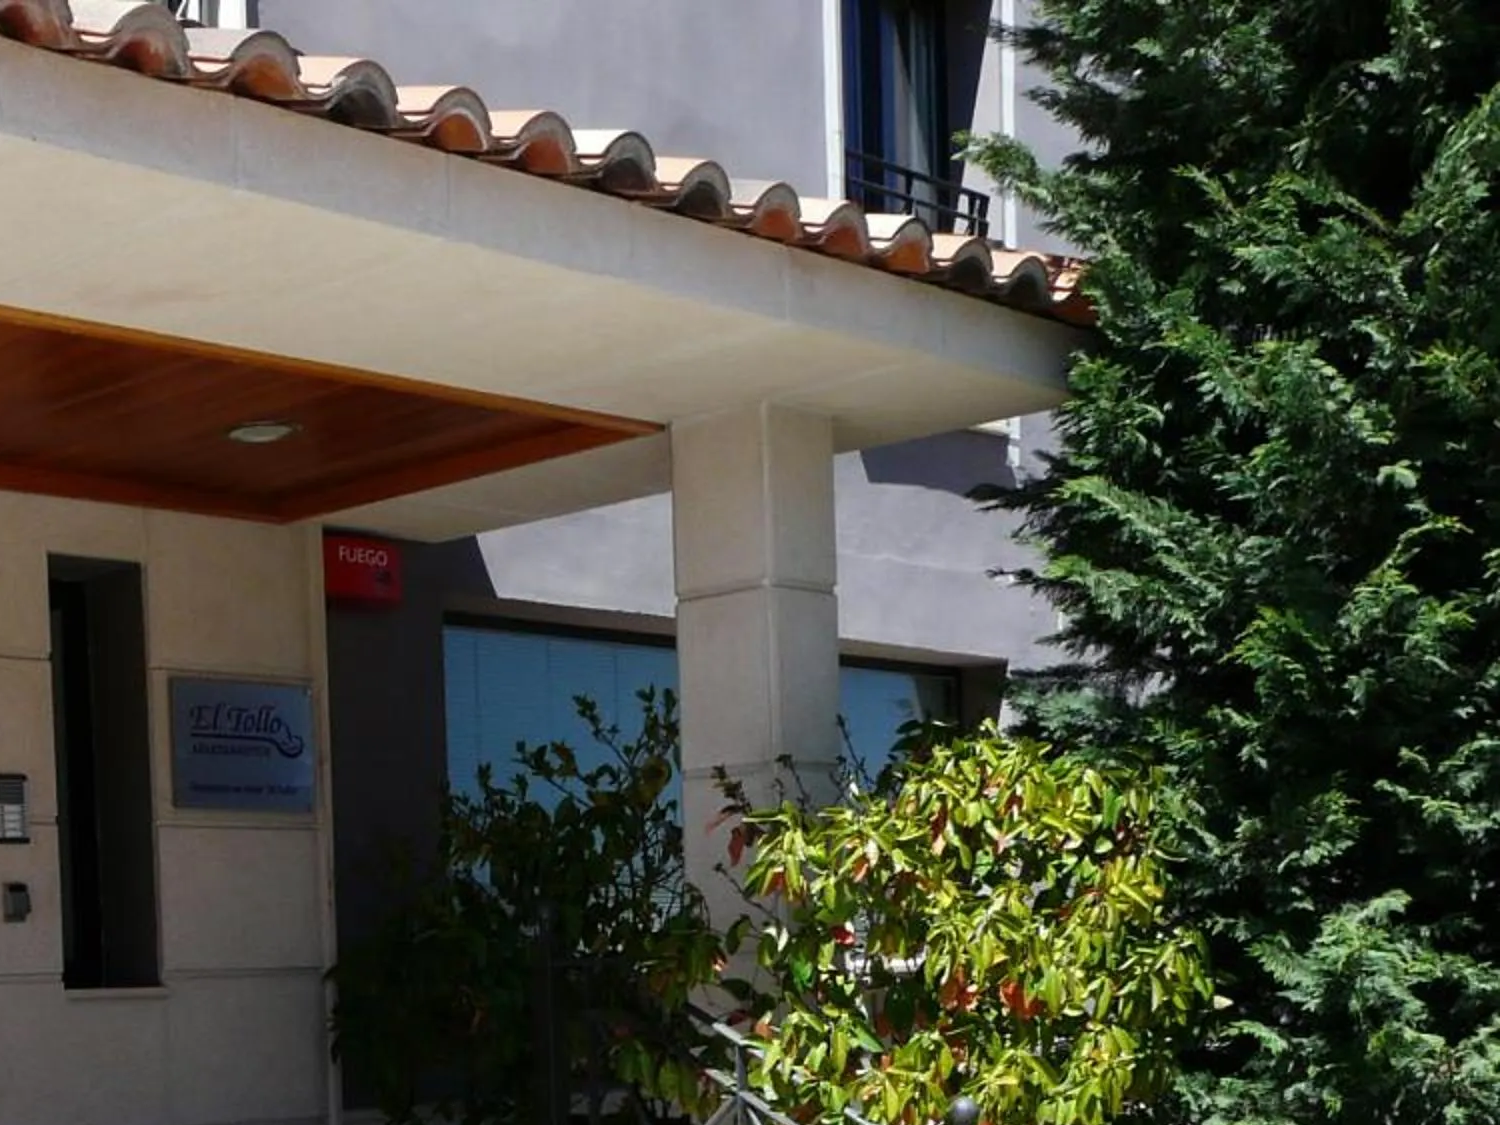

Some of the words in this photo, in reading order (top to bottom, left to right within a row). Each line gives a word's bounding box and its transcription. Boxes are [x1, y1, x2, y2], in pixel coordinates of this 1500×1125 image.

[338, 545, 388, 567] FUEGO
[189, 702, 225, 731] El
[227, 705, 282, 734] Tollo
